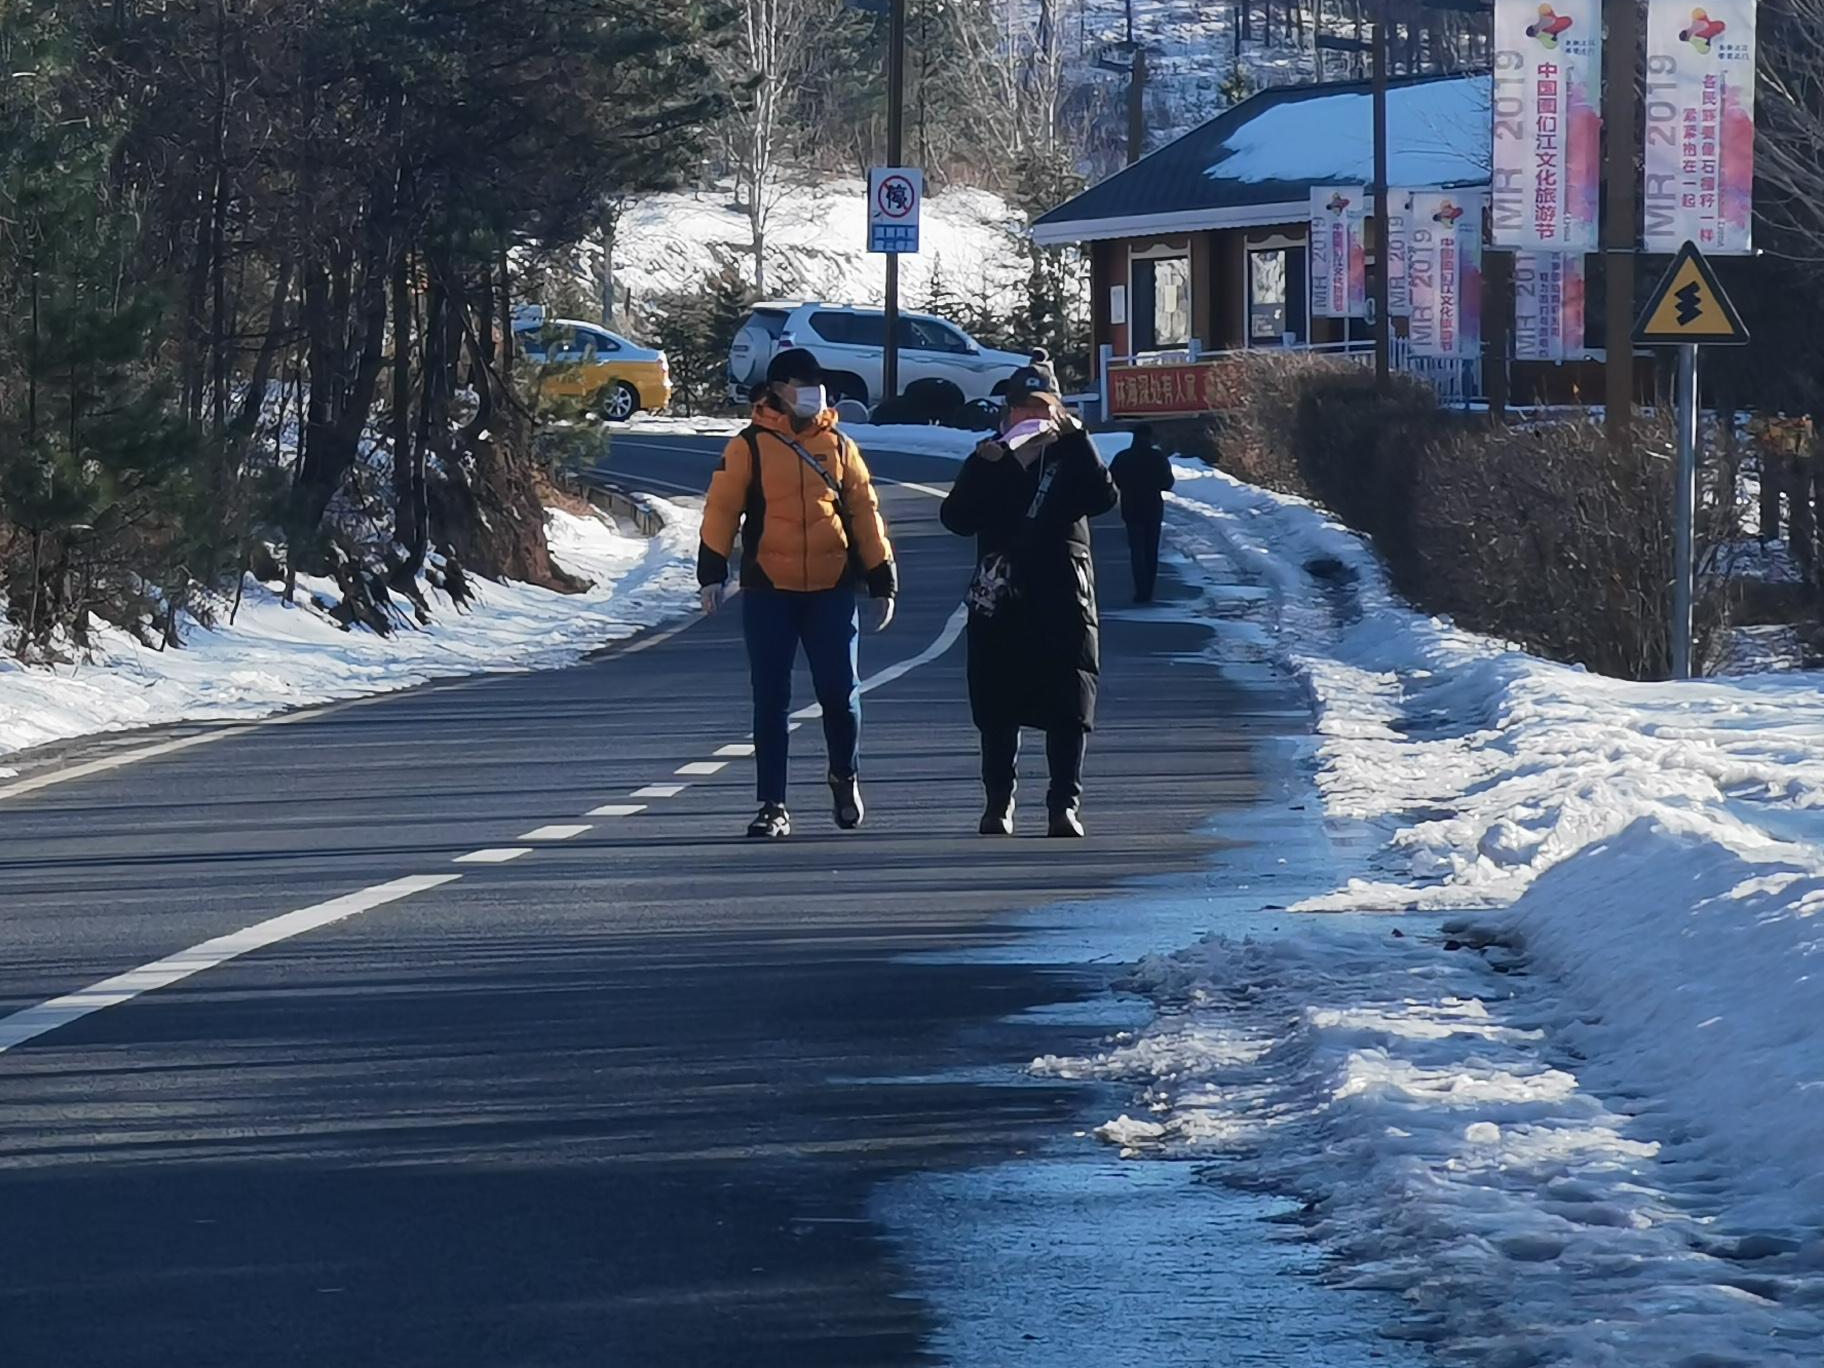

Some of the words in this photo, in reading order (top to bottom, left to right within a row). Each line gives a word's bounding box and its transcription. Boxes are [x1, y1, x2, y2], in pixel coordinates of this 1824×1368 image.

[1495, 50, 1525, 141] 2019
[1647, 54, 1677, 146] 2019
[1535, 62, 1559, 240] 中国图们江文化旅游节
[1495, 168, 1523, 231] MR
[1646, 173, 1676, 237] MR
[1313, 216, 1327, 263] 2019
[1389, 216, 1406, 262] 2019
[1412, 229, 1433, 289] 2019
[1516, 254, 1537, 298] 201
[1413, 305, 1433, 346] MR
